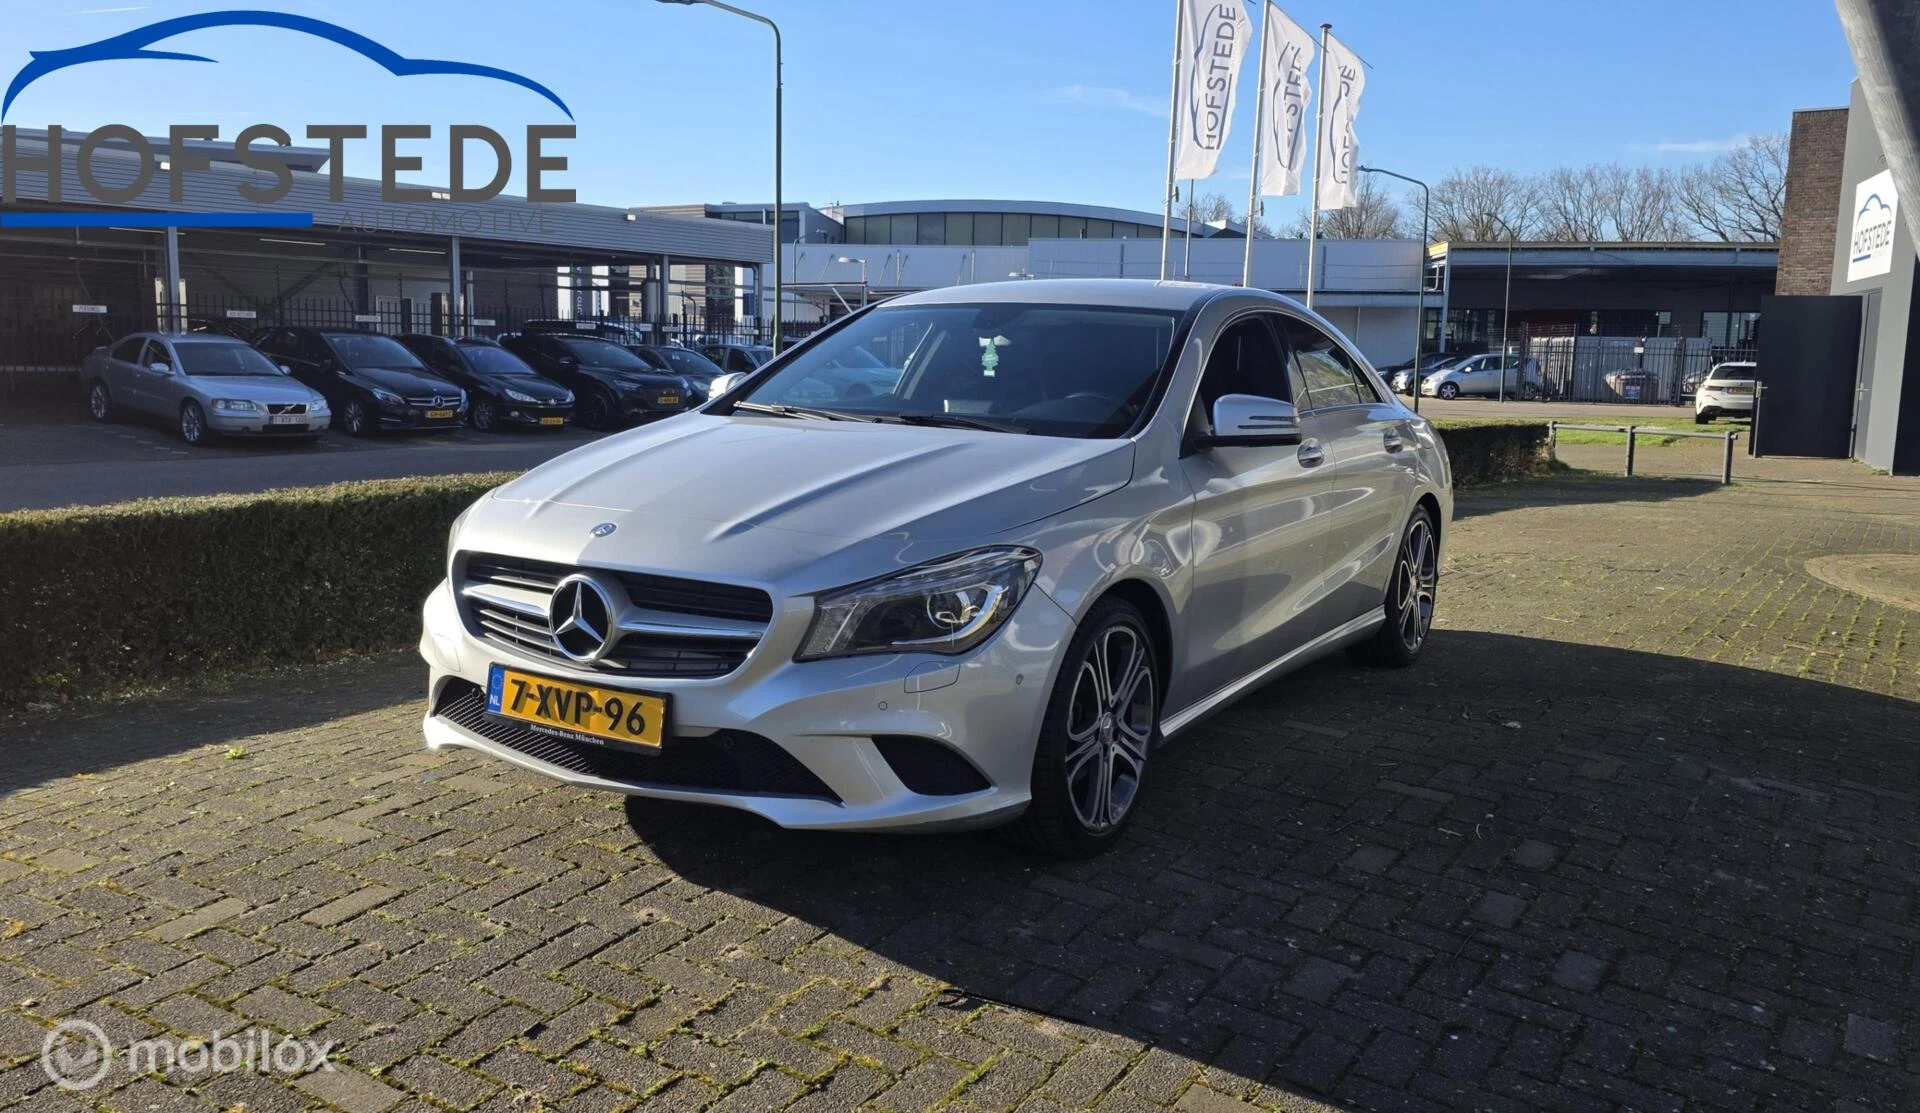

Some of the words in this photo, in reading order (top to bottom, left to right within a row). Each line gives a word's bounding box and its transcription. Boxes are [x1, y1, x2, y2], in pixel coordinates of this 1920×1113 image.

[1204, 4, 1236, 150] HOFSTEDE
[1853, 220, 1892, 255] HOFSTEDE
[489, 694, 501, 707] NL
[511, 680, 646, 736] 7-XVP-96
[530, 724, 574, 740] Mercedes-Benz
[575, 733, 605, 745] München
